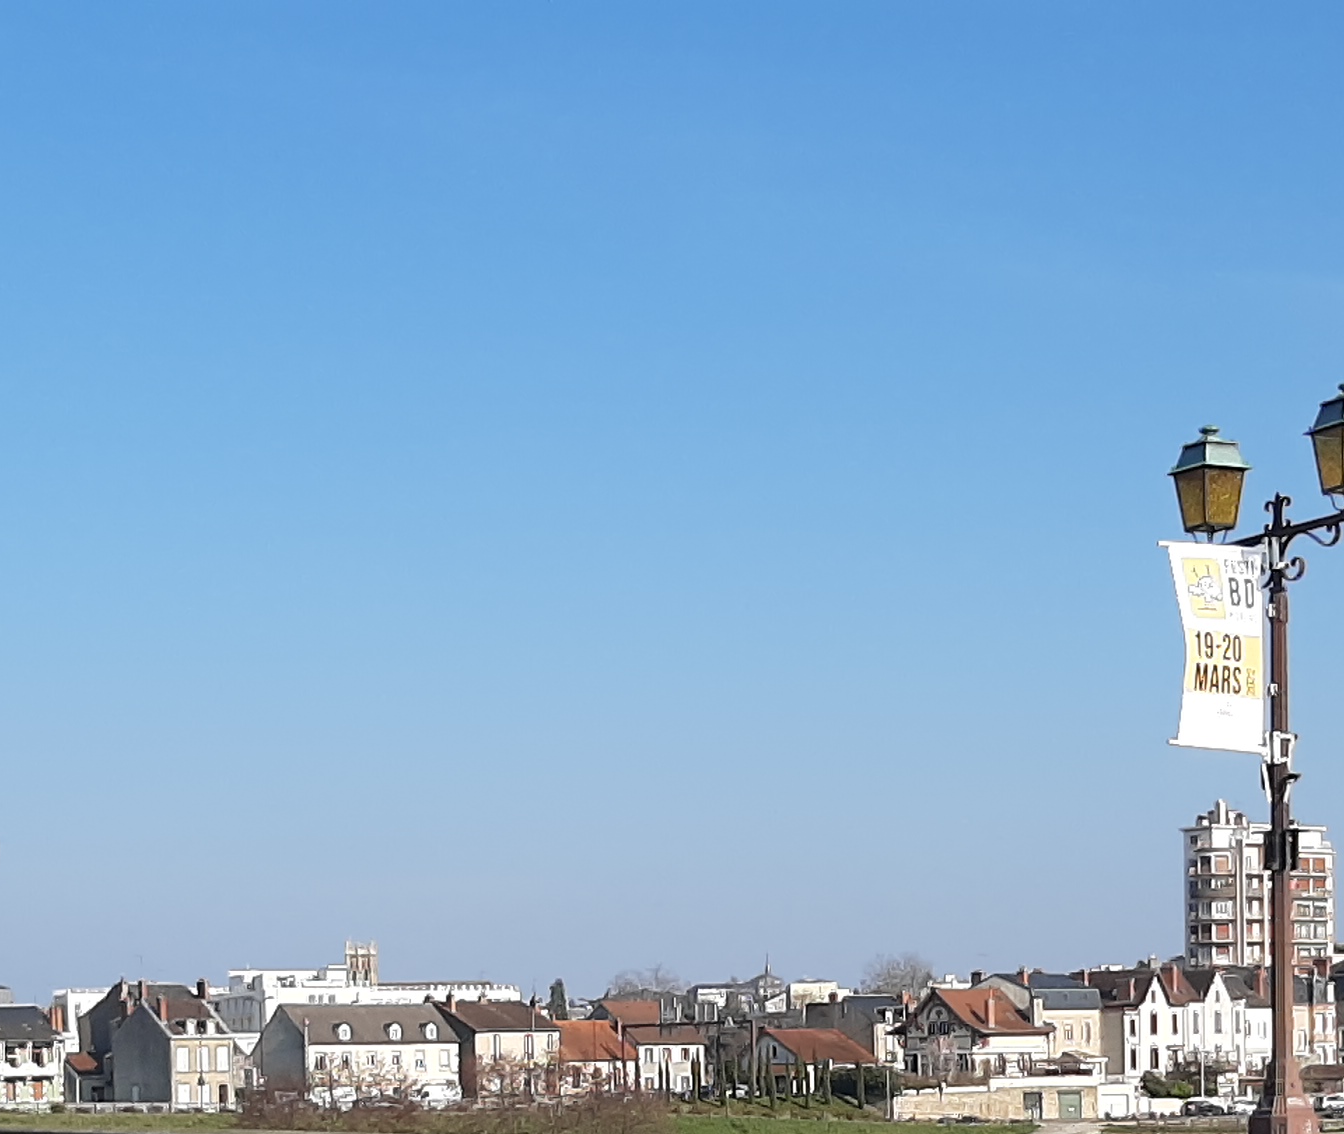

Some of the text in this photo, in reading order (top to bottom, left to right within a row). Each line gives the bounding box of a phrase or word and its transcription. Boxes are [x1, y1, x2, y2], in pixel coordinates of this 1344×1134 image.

[1228, 577, 1255, 608] BD
[1195, 630, 1242, 662] 19-20
[1194, 662, 1242, 694] MARS
